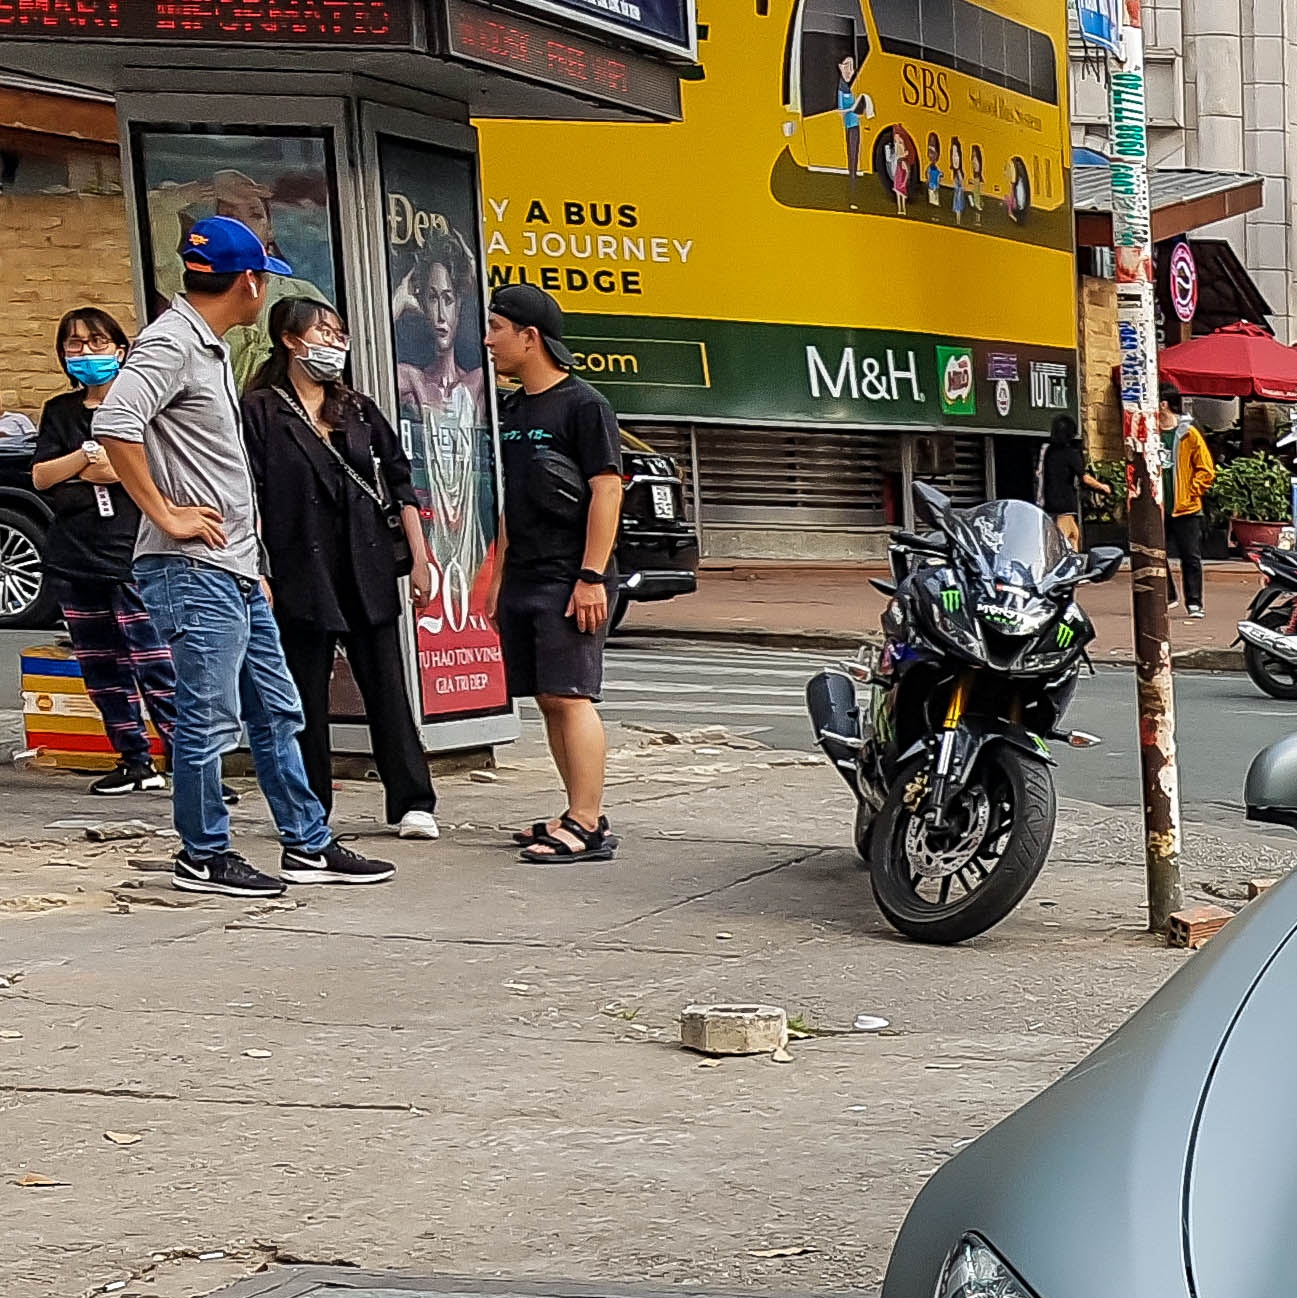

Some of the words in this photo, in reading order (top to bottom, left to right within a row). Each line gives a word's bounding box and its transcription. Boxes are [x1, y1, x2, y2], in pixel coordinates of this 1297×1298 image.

[902, 63, 950, 113] SBS
[525, 200, 550, 225] A
[563, 202, 638, 228] BUS
[487, 231, 511, 255] A
[522, 232, 693, 263] JOURNEY
